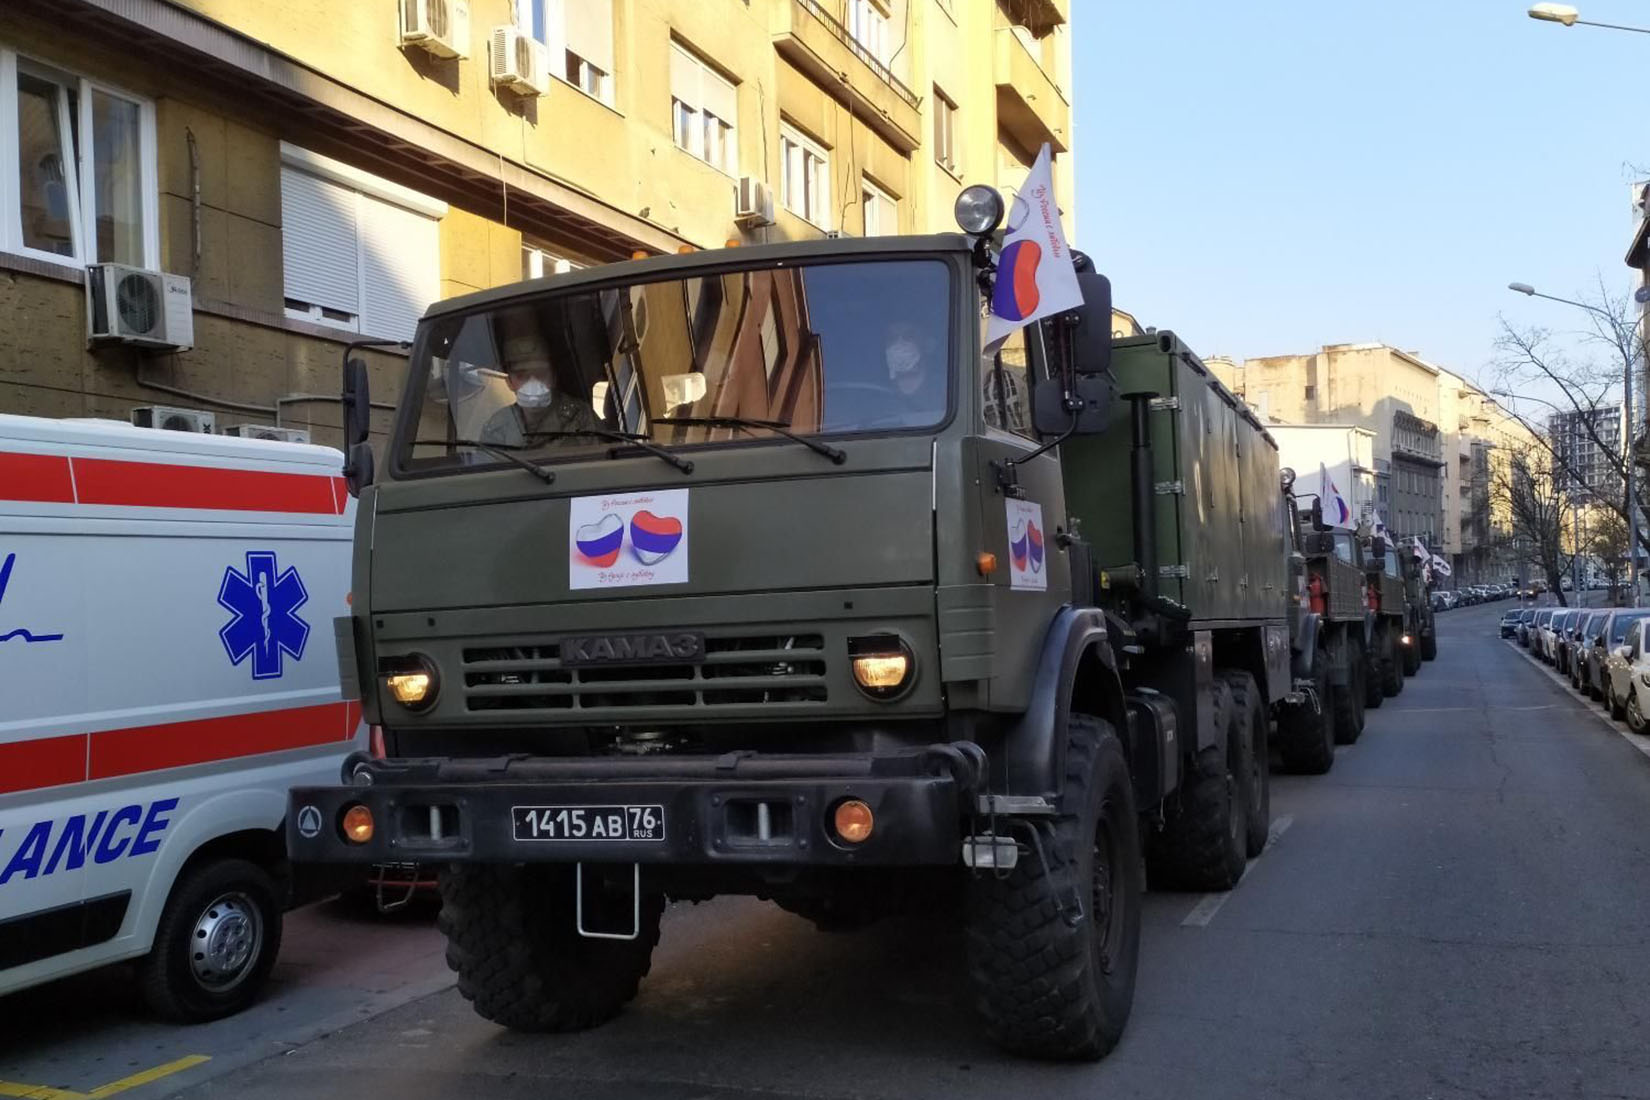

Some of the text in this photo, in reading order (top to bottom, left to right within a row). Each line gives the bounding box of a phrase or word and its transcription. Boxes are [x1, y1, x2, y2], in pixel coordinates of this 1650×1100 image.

[564, 633, 699, 661] КАМАЗ
[525, 810, 587, 837] 1415
[629, 807, 656, 830] 76
[0, 797, 180, 885] ANCE
[633, 829, 653, 838] RUS
